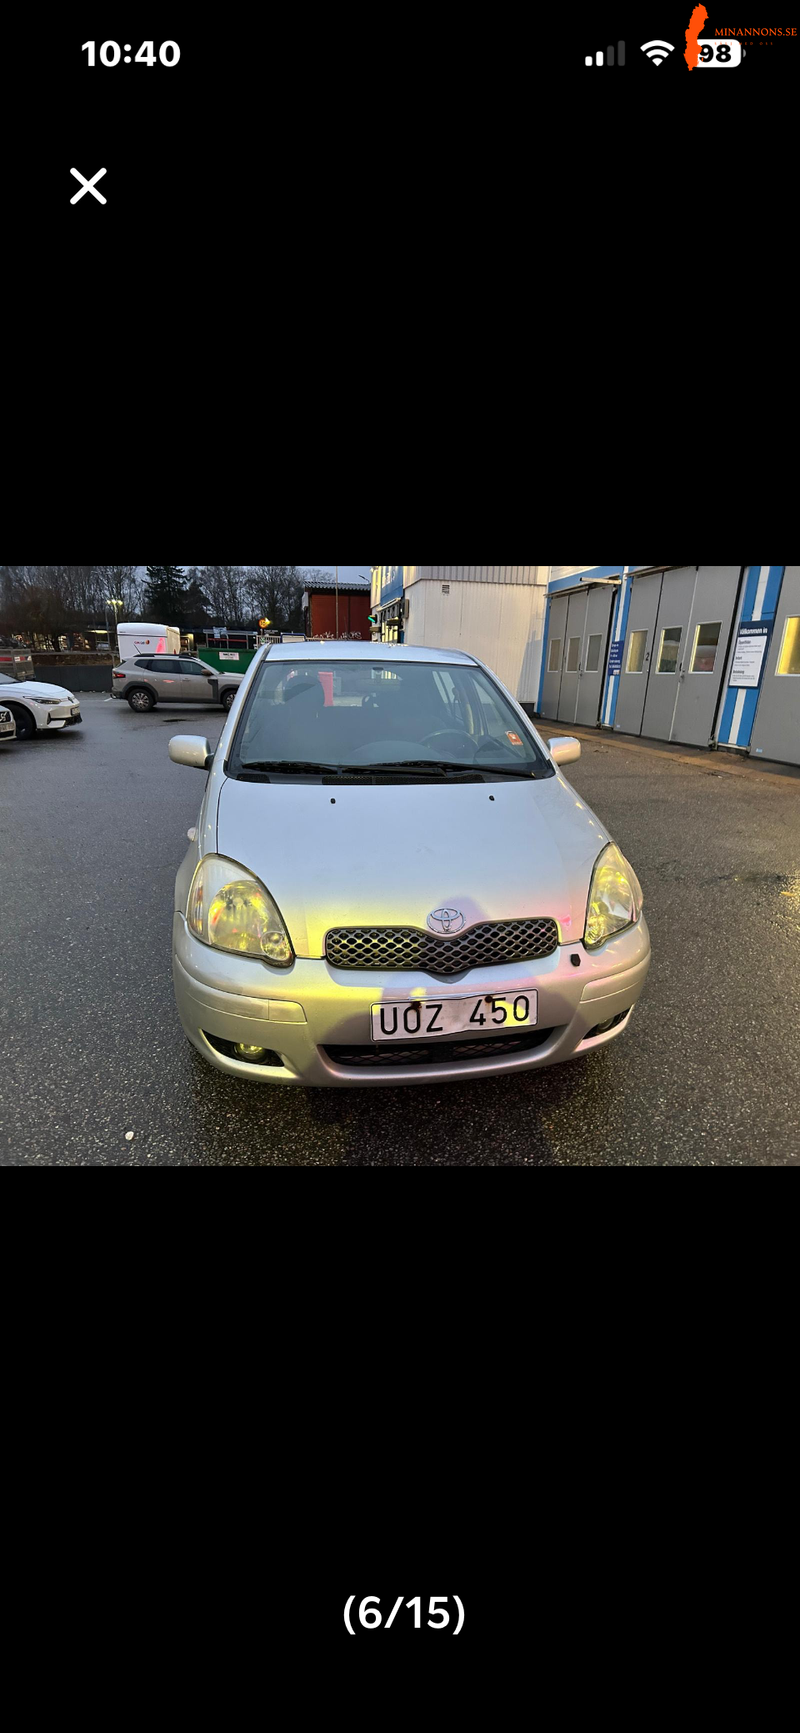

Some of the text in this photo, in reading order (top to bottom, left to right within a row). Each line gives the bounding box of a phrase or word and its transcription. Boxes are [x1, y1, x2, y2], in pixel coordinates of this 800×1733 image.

[645, 652, 650, 661] 2
[380, 995, 530, 1035] UOZ 450
